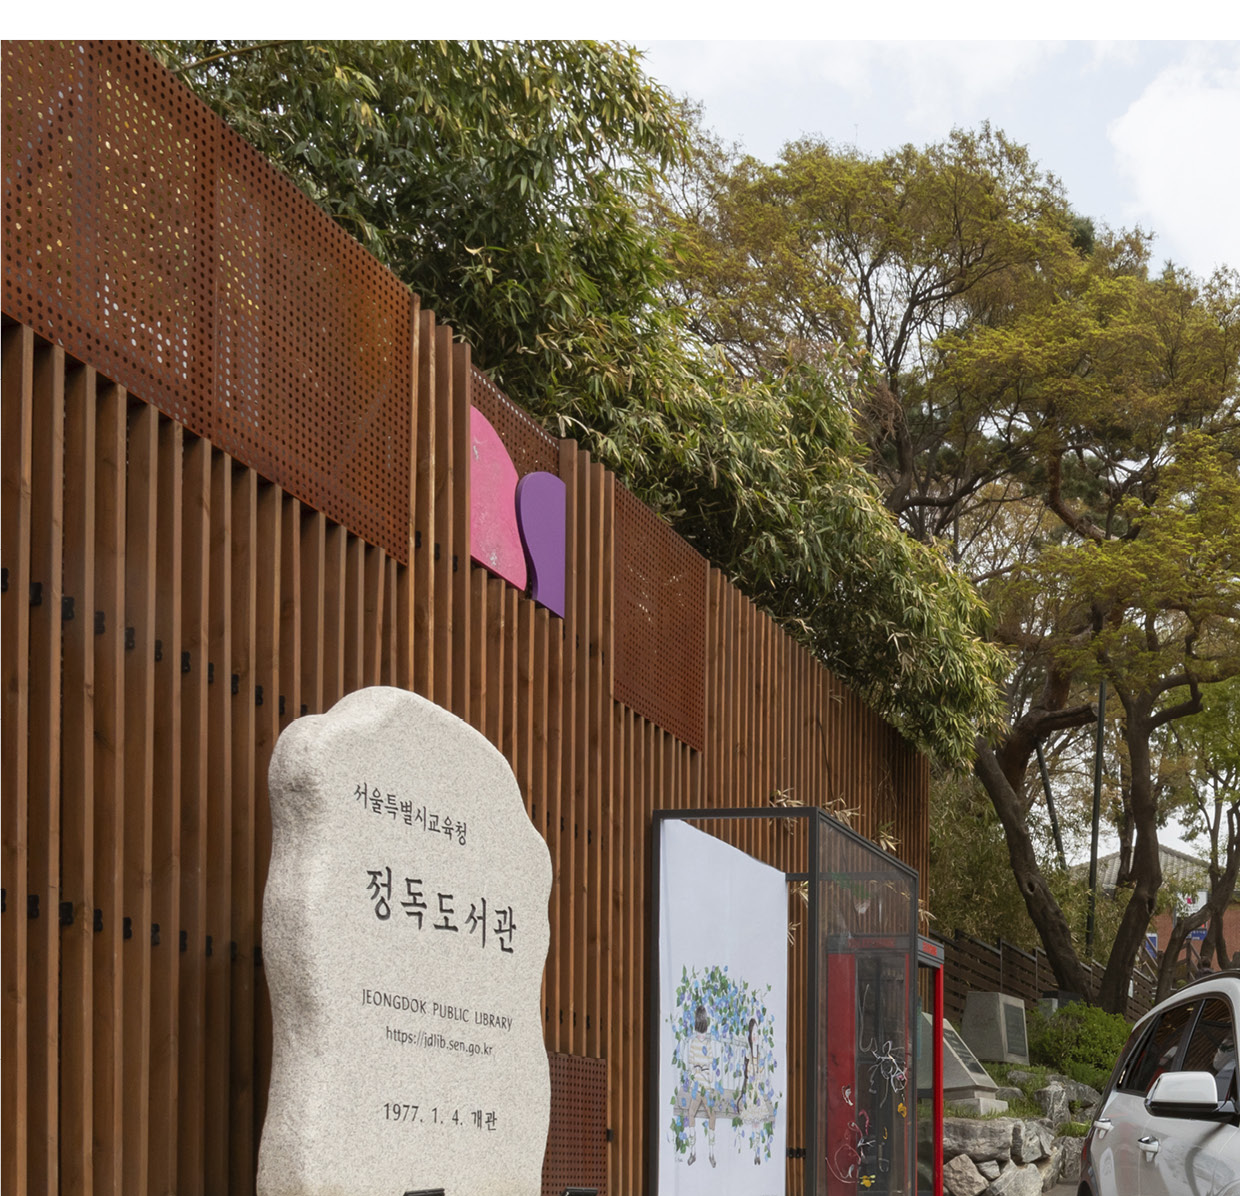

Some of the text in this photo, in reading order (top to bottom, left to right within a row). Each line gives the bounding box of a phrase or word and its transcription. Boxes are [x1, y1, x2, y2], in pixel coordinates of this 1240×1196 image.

[354, 782, 467, 846] 서울특별시교육청
[366, 866, 517, 954] 정독도서관
[362, 988, 513, 1033] JEONGDOK PUBLIC LIBRARY
[386, 1026, 493, 1057] https://jdlib.sen.go.kr
[383, 1103, 498, 1131] 1977. 1. 4. 개관
